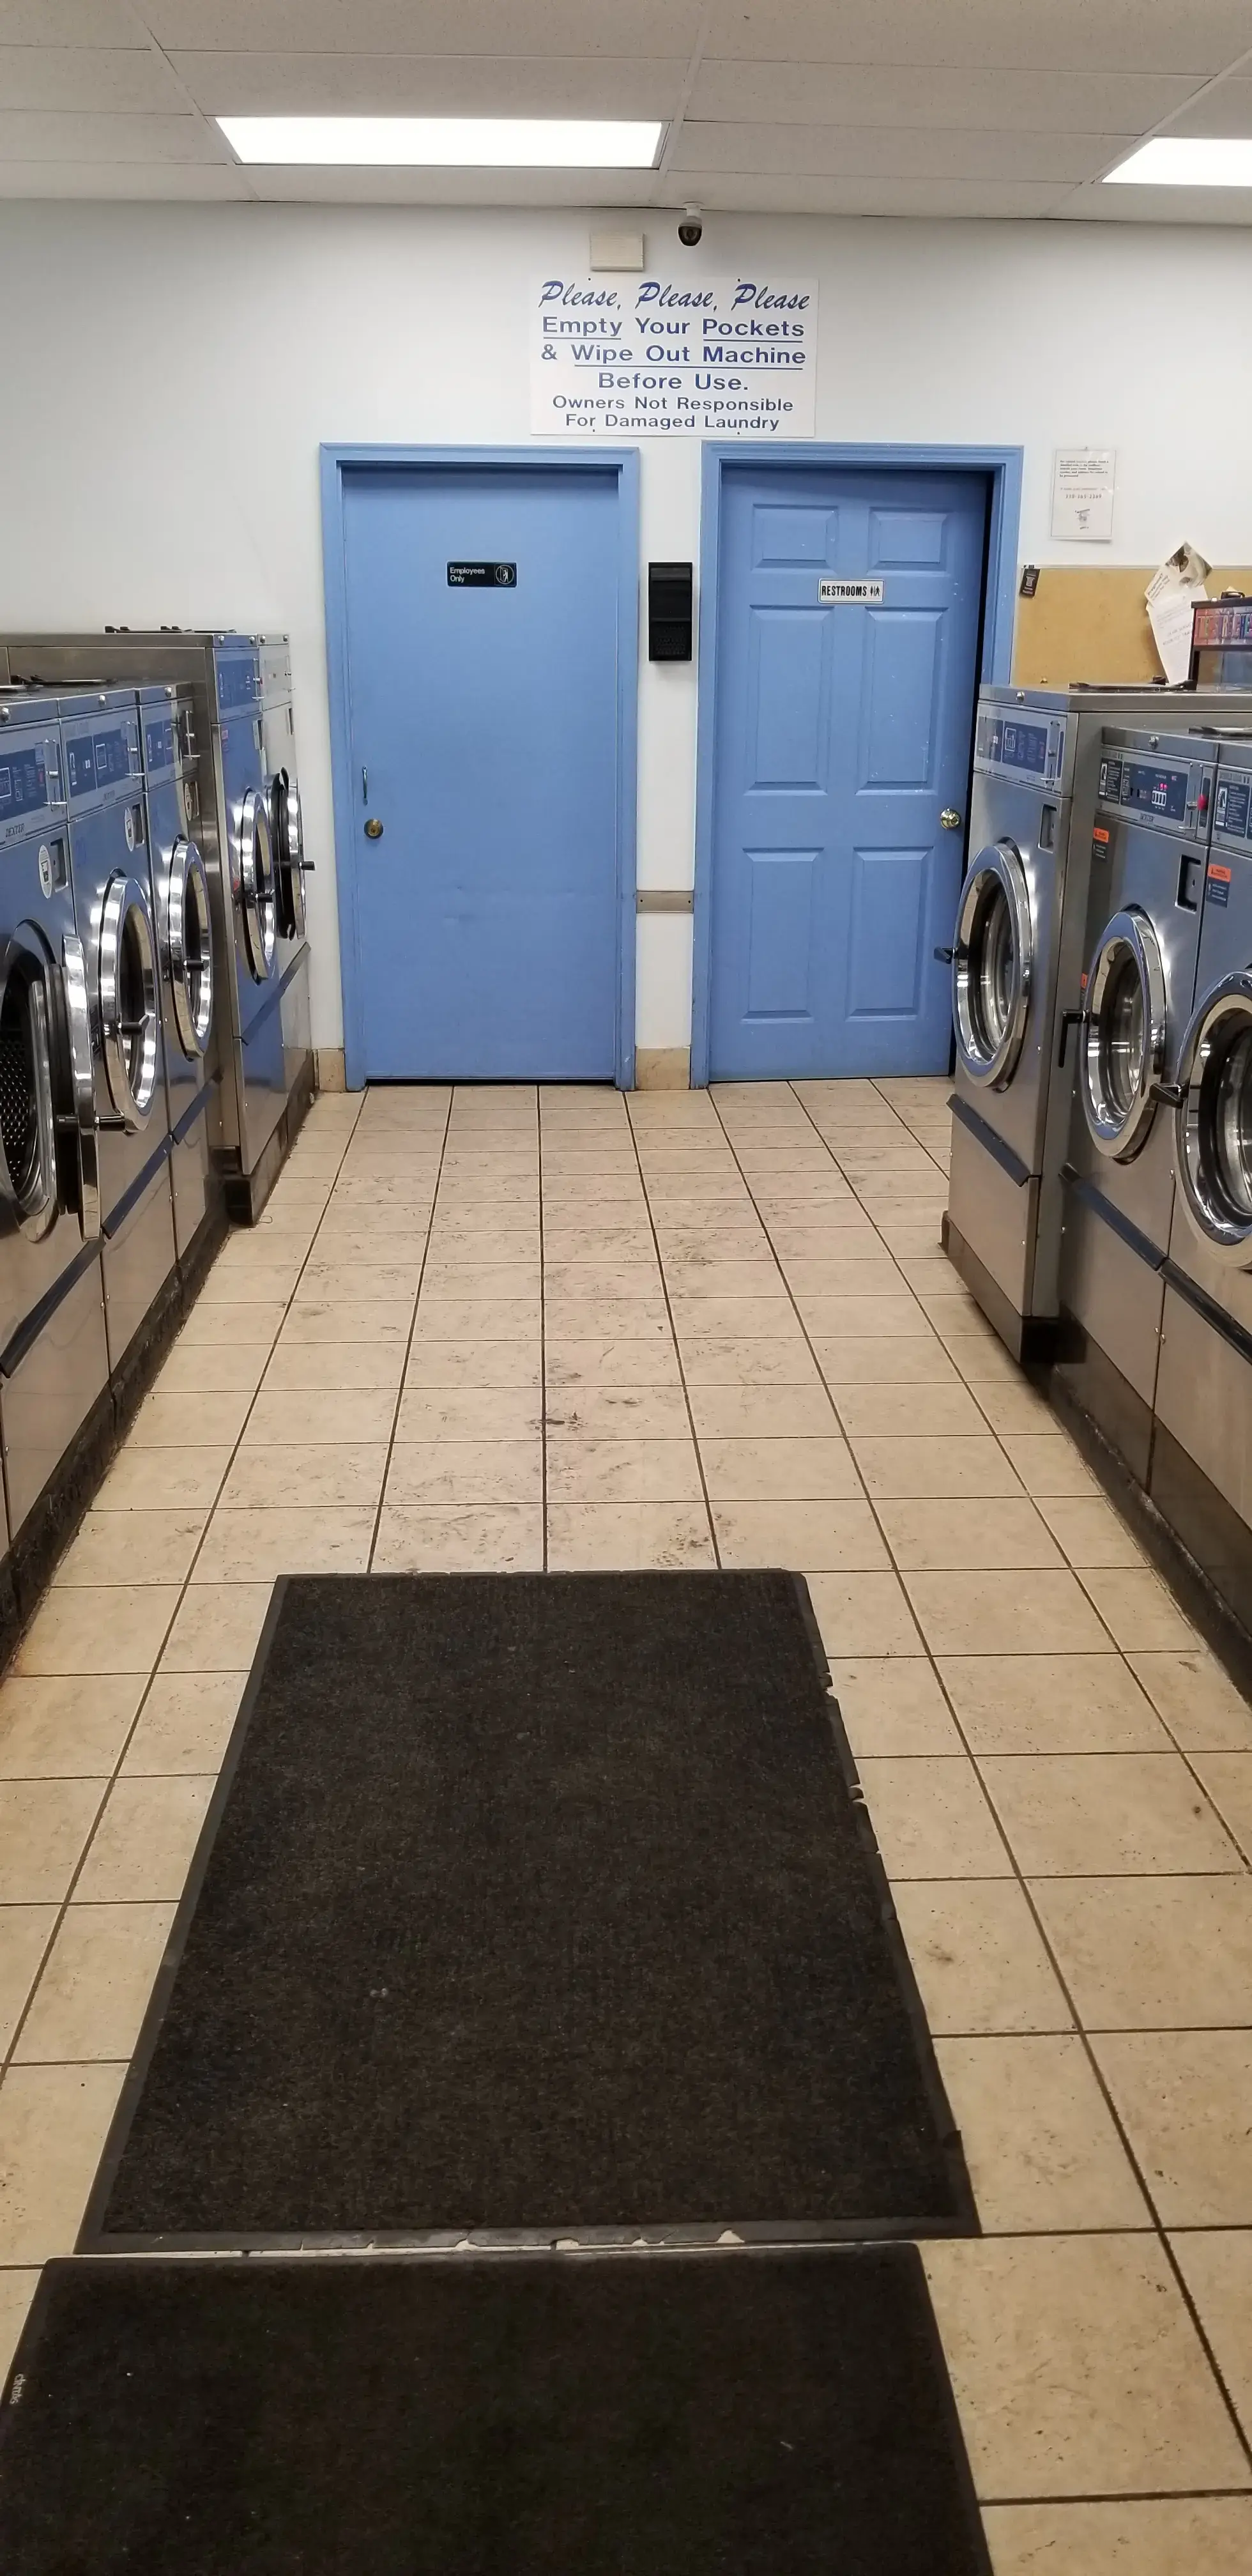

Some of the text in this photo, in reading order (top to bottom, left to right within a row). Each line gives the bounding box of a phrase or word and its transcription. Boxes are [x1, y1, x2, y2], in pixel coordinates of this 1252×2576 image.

[538, 280, 810, 312] Please, Please, Please
[543, 316, 804, 337] Empty Your Pockets
[541, 344, 806, 364] & Wipe Out Machine
[599, 372, 748, 390] Before Use.
[553, 395, 793, 413] Owners Not Responsible
[566, 413, 780, 431] For Damaged Laundry
[450, 575, 465, 583] Only
[821, 585, 867, 596] RESTROOMS
